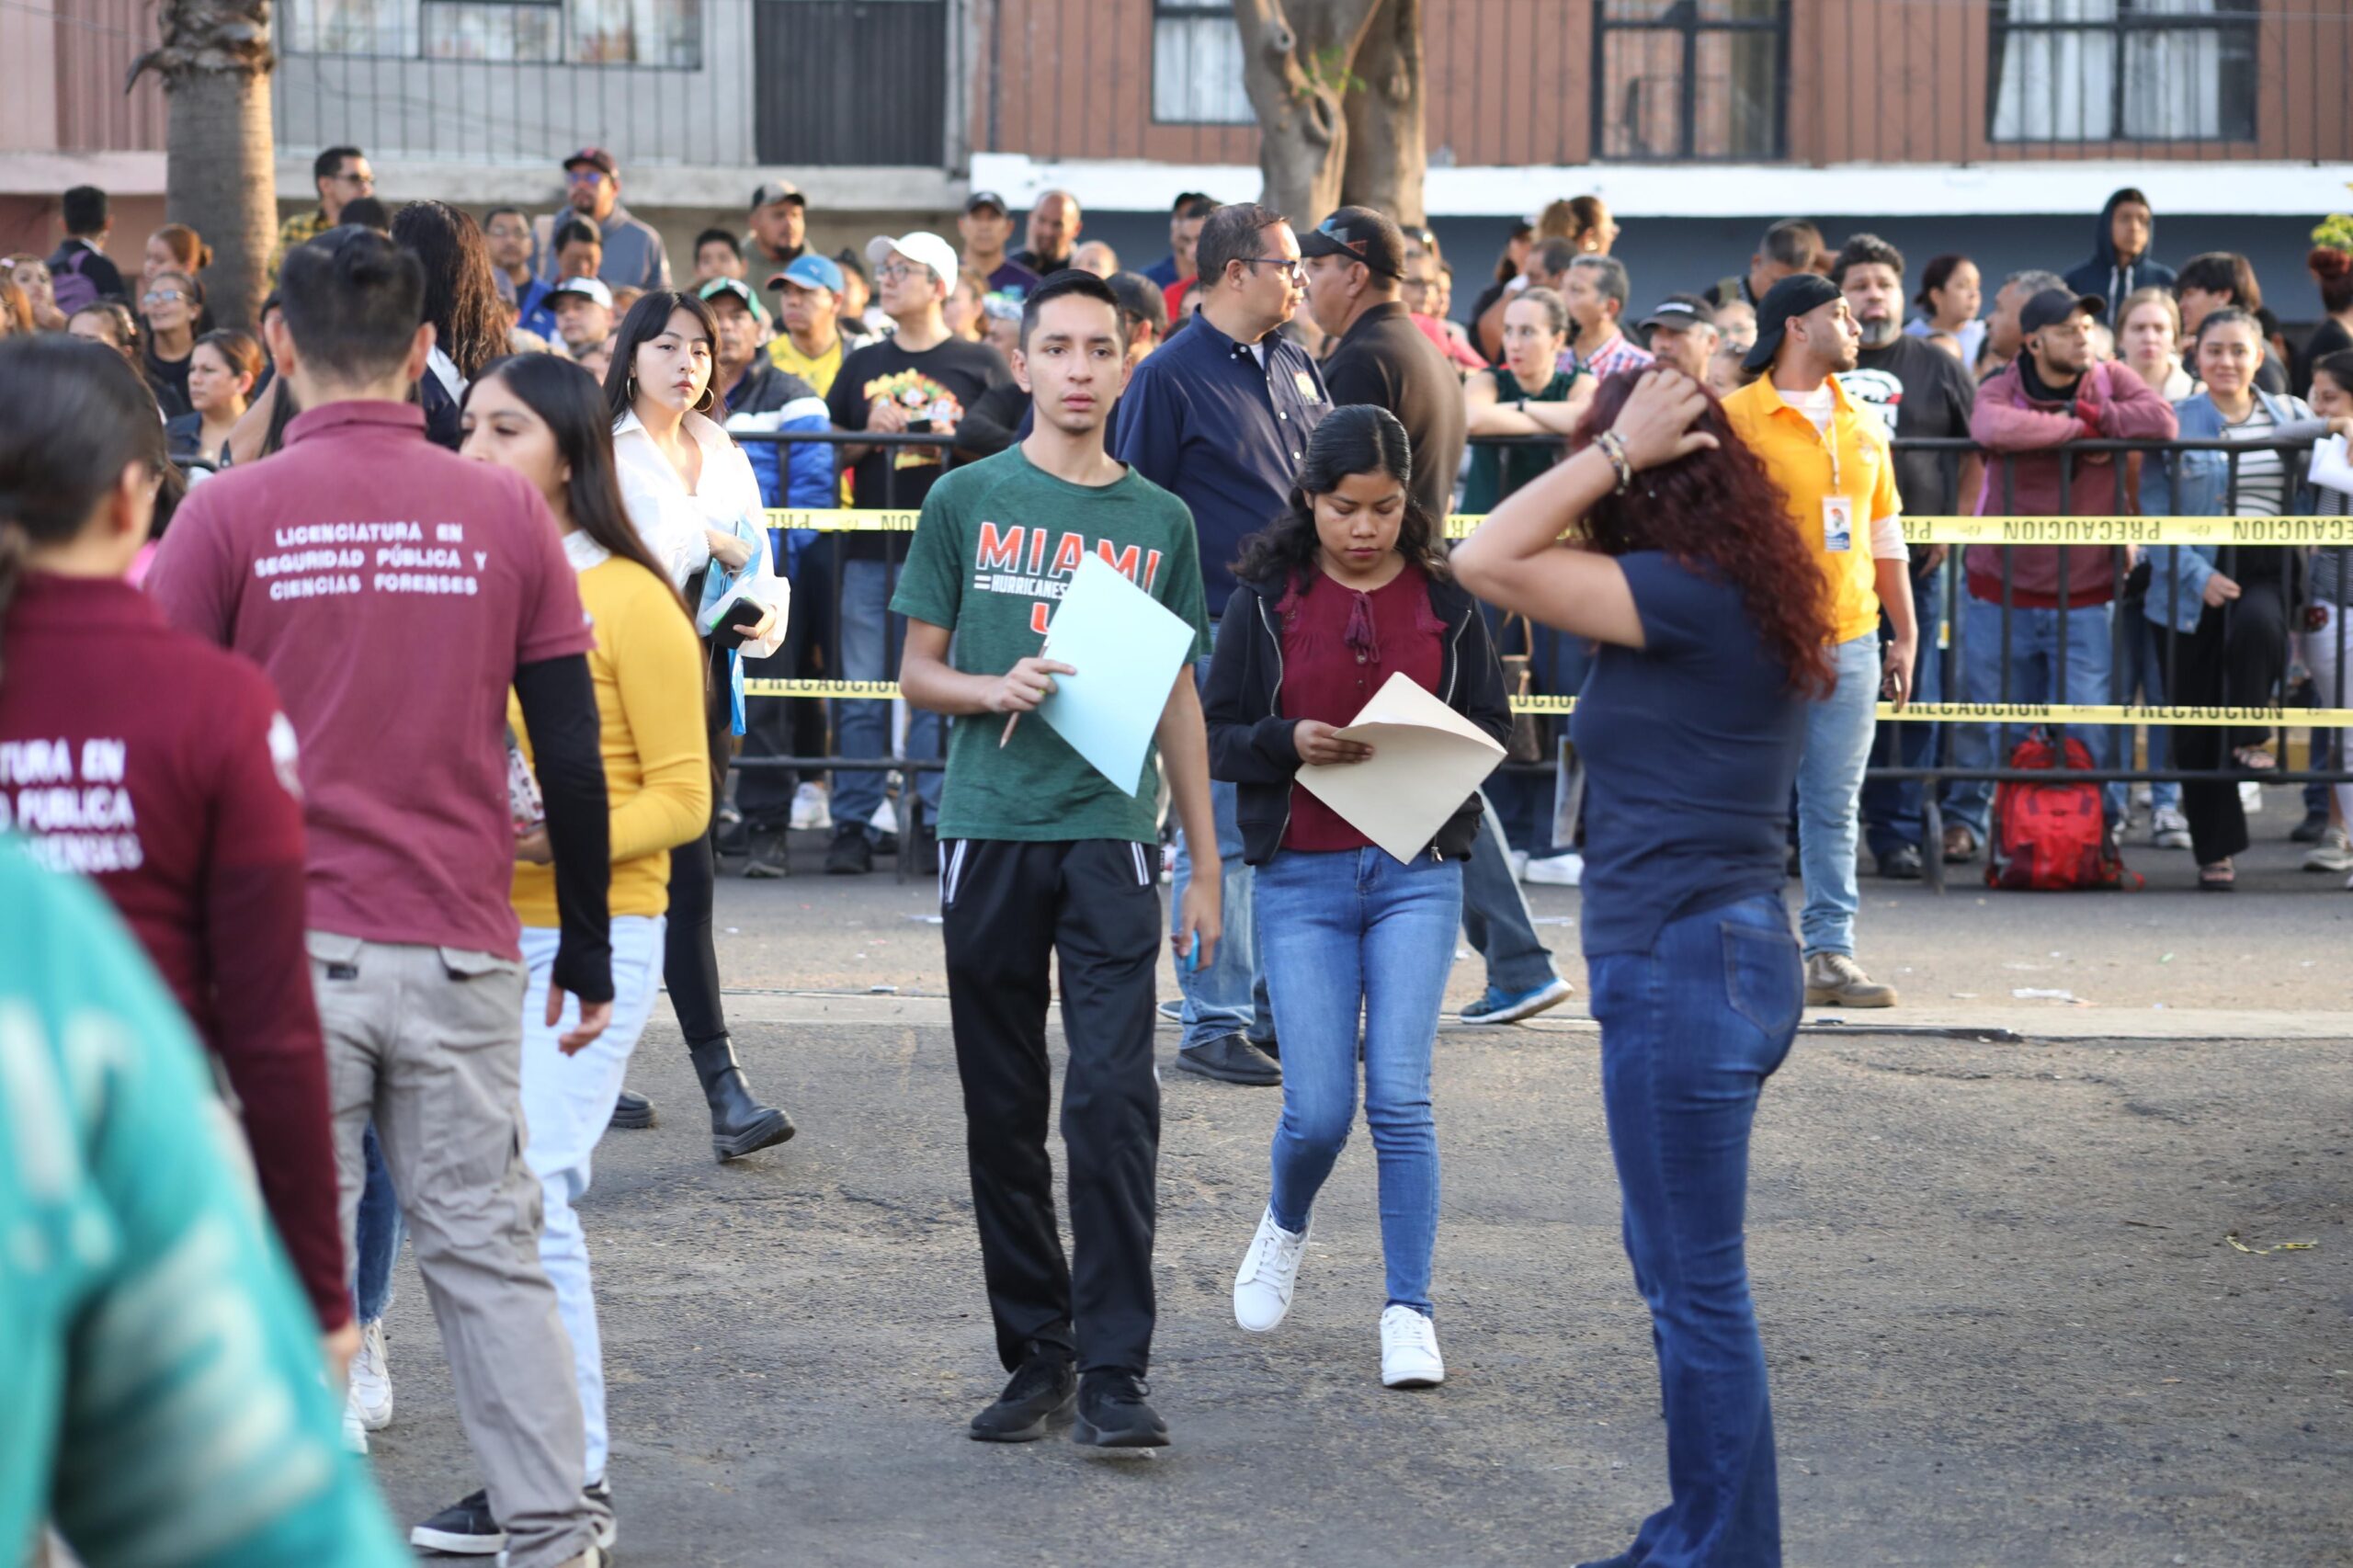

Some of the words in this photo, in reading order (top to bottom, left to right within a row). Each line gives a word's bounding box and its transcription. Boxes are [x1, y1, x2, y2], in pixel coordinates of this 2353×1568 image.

[276, 520, 424, 547] LICENCIATURA
[436, 523, 464, 542] EN
[2003, 520, 2161, 540] PRECAUCION
[254, 548, 366, 578] SEGURIDAD
[375, 543, 462, 569] PÚBLICA
[472, 551, 488, 572] Y
[975, 521, 1161, 595] MIAMI
[269, 573, 362, 600] CIENCIAS
[373, 572, 479, 596] FORENSES
[991, 574, 1068, 600] HURRICANES
[81, 737, 126, 784] EN
